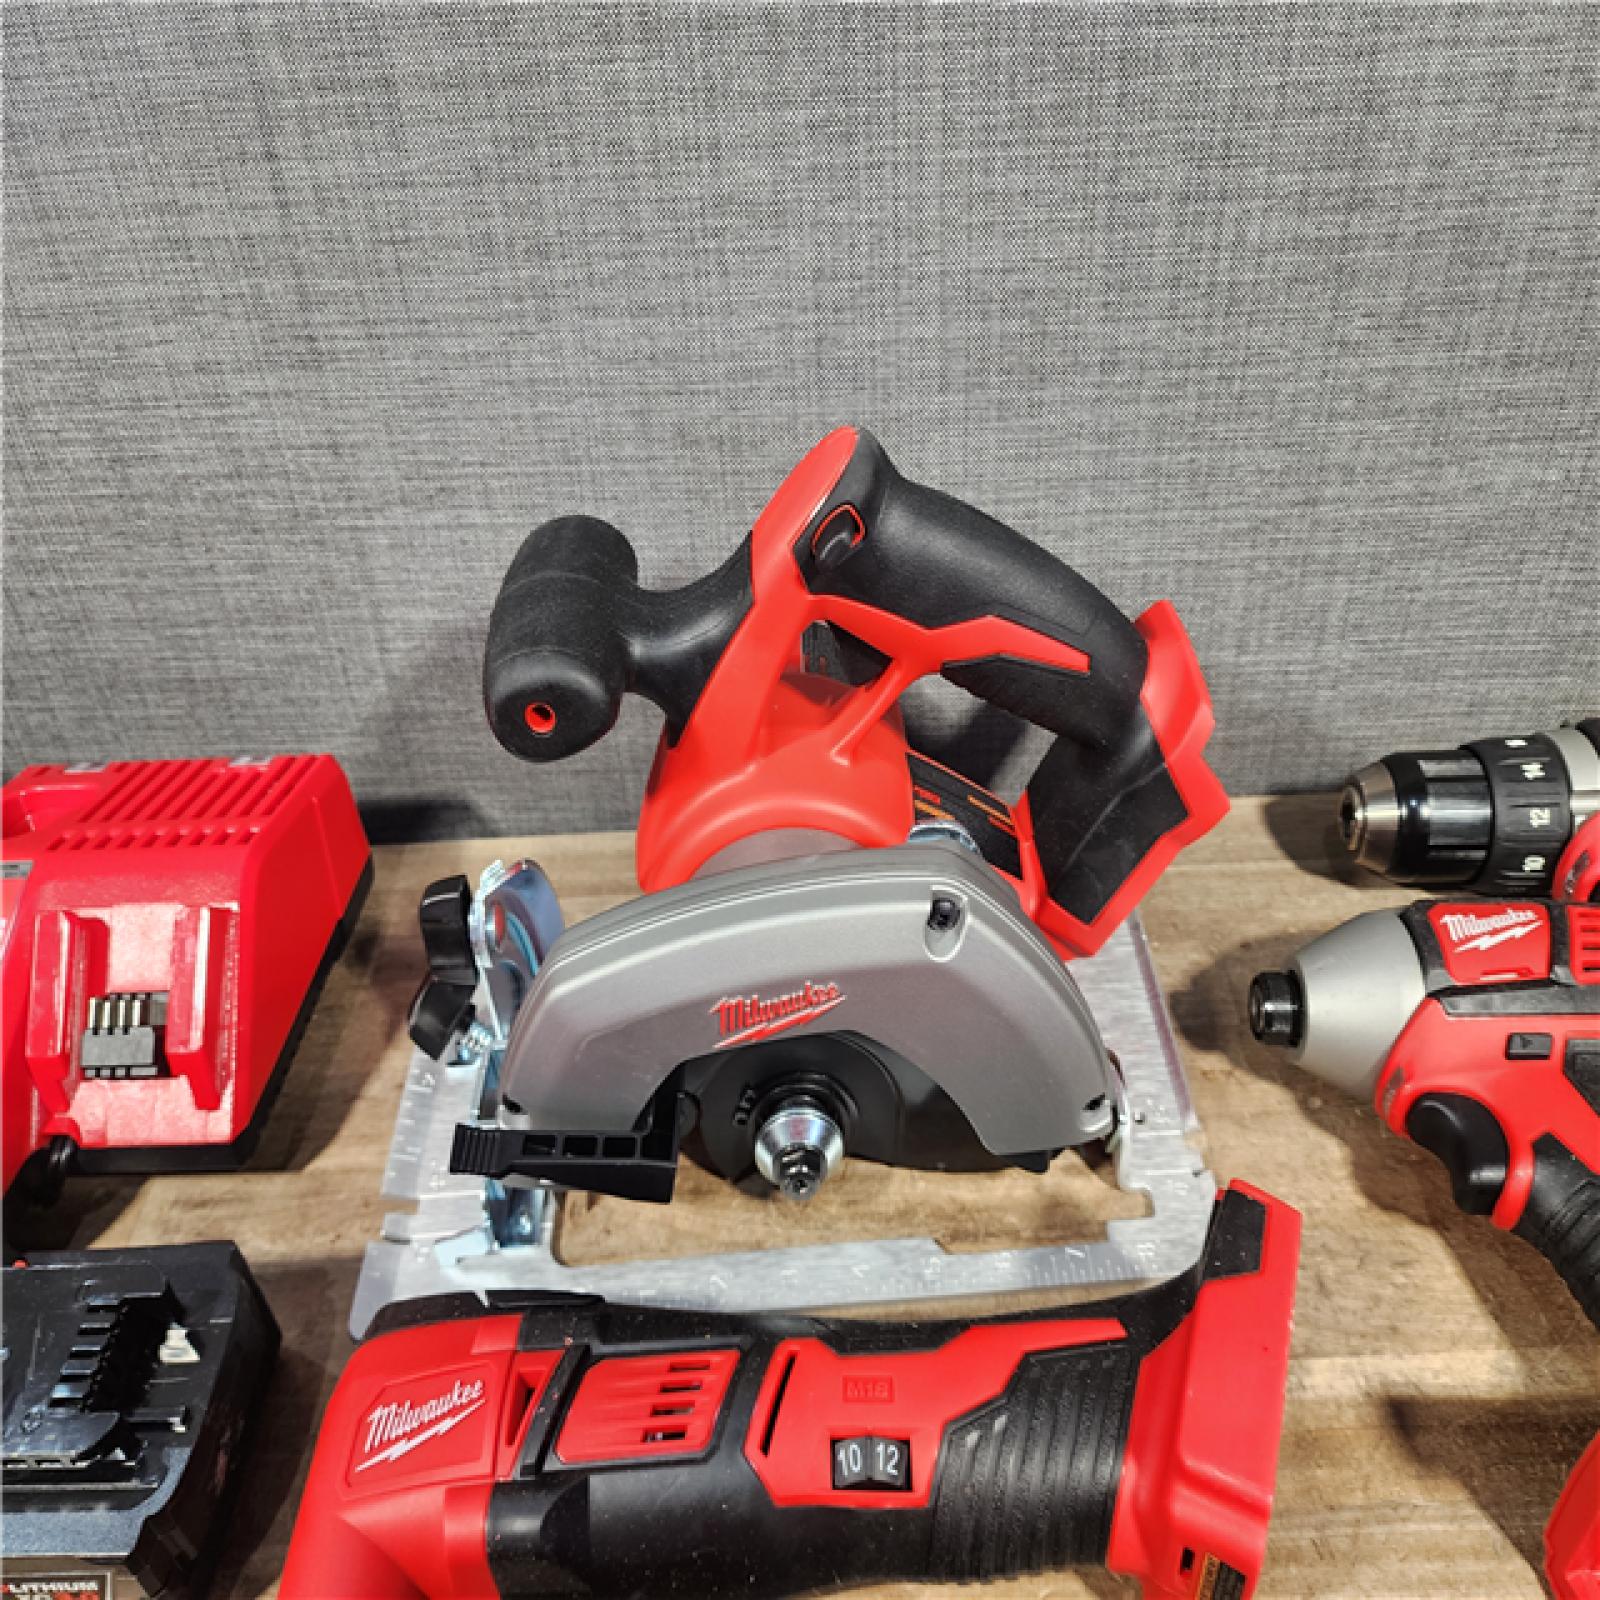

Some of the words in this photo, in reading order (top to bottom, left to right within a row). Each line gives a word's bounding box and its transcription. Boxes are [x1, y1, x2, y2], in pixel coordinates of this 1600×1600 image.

[1530, 808, 1551, 828] 12
[1522, 854, 1546, 873] 10
[1440, 907, 1538, 943] Milwaukee
[708, 979, 840, 1037] Milwaukee
[364, 1379, 484, 1454] Milwaukee
[837, 1443, 861, 1476] 10
[877, 1442, 900, 1476] 12
